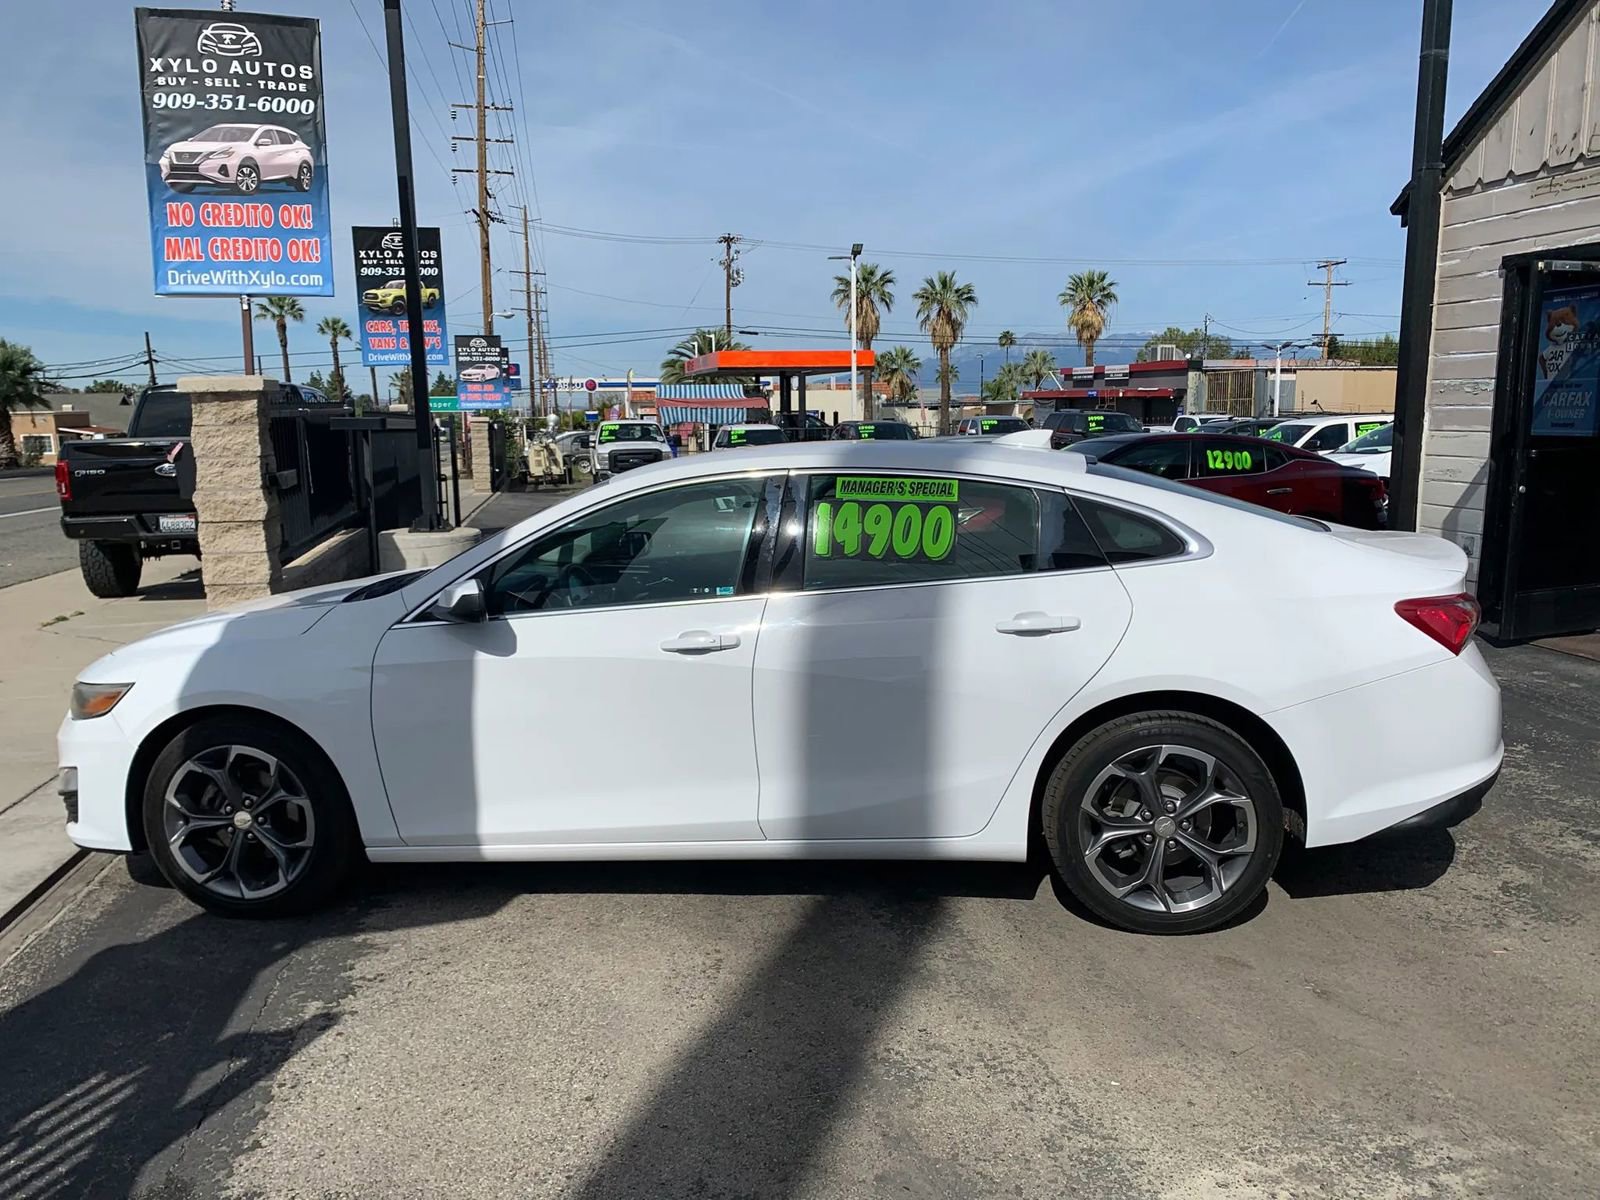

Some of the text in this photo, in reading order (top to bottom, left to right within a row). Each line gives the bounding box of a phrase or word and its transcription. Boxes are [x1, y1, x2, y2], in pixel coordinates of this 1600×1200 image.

[150, 57, 313, 80] XYLO AUTOS
[157, 77, 187, 86] BUY
[204, 77, 241, 88] SELL
[258, 80, 307, 92] TRADE
[152, 92, 315, 115] 909-351-6000
[166, 202, 313, 229] NO CREDITO OK!
[164, 237, 321, 263] MAL CREDITO OK!
[359, 250, 438, 258] XYLO AOS
[167, 270, 323, 289] DriveWithXylo.com
[366, 320, 396, 335] CARS,
[368, 337, 396, 350] VANS
[399, 337, 409, 350] &
[1542, 391, 1593, 407] CARFAX
[1206, 449, 1252, 470] 12900
[840, 479, 955, 497] MANAGER'S SPECIAL
[814, 502, 955, 561] 14900
